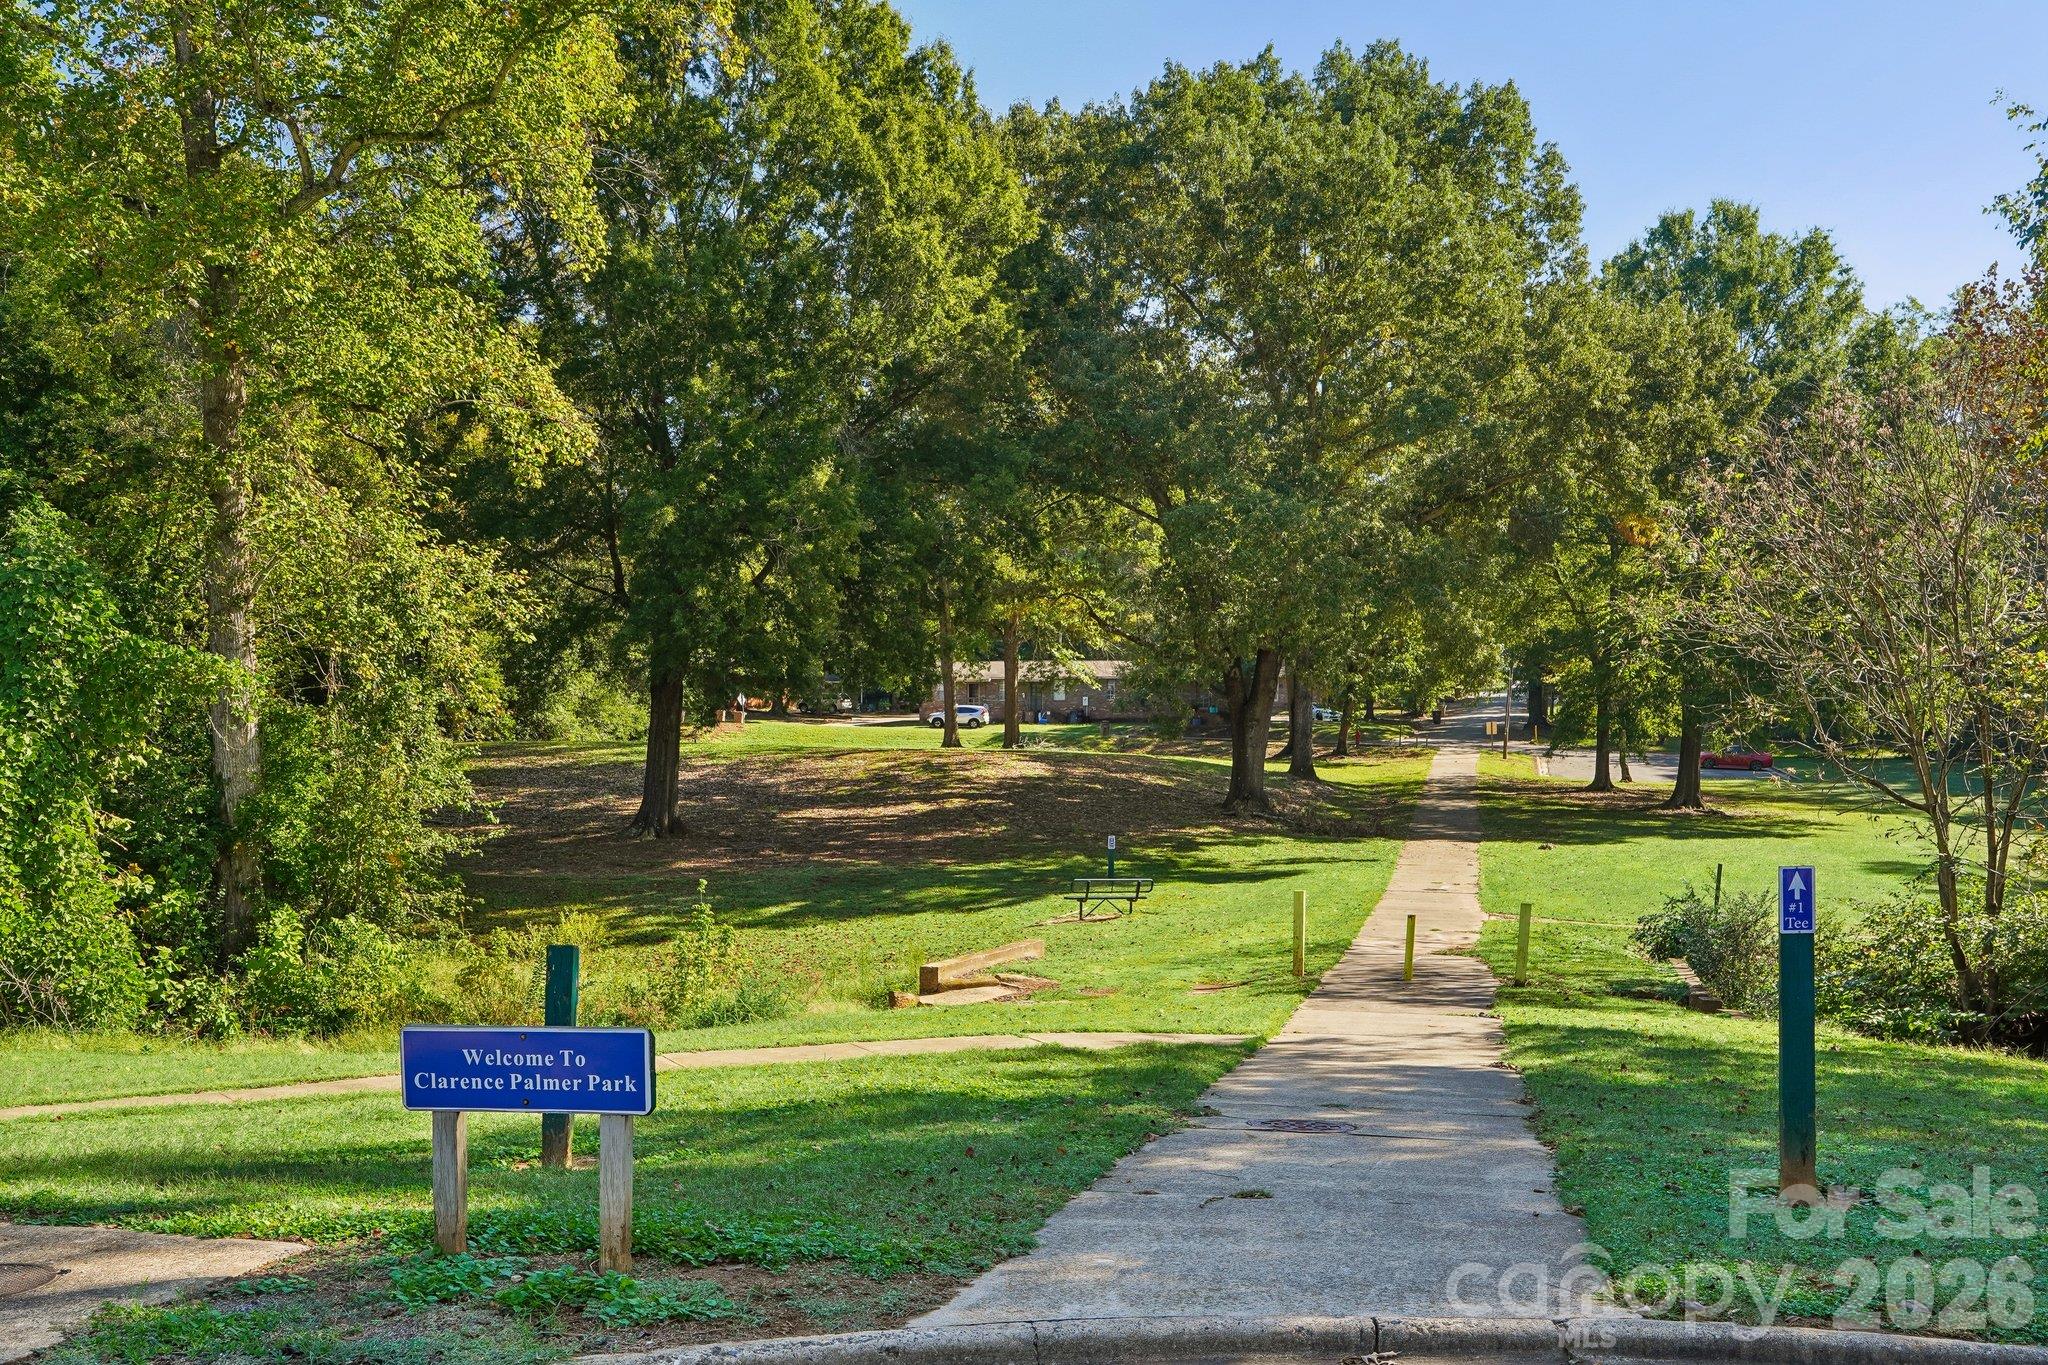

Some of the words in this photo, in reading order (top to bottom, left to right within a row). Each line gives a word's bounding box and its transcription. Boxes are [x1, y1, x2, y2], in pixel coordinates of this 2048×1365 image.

[1788, 902, 1804, 913] #1
[1785, 917, 1809, 929] Tee
[462, 1049, 554, 1067] Welcome
[559, 1050, 586, 1067] To
[413, 1072, 504, 1090] Clarence
[510, 1073, 582, 1091] Palmer
[587, 1074, 637, 1093] Park
